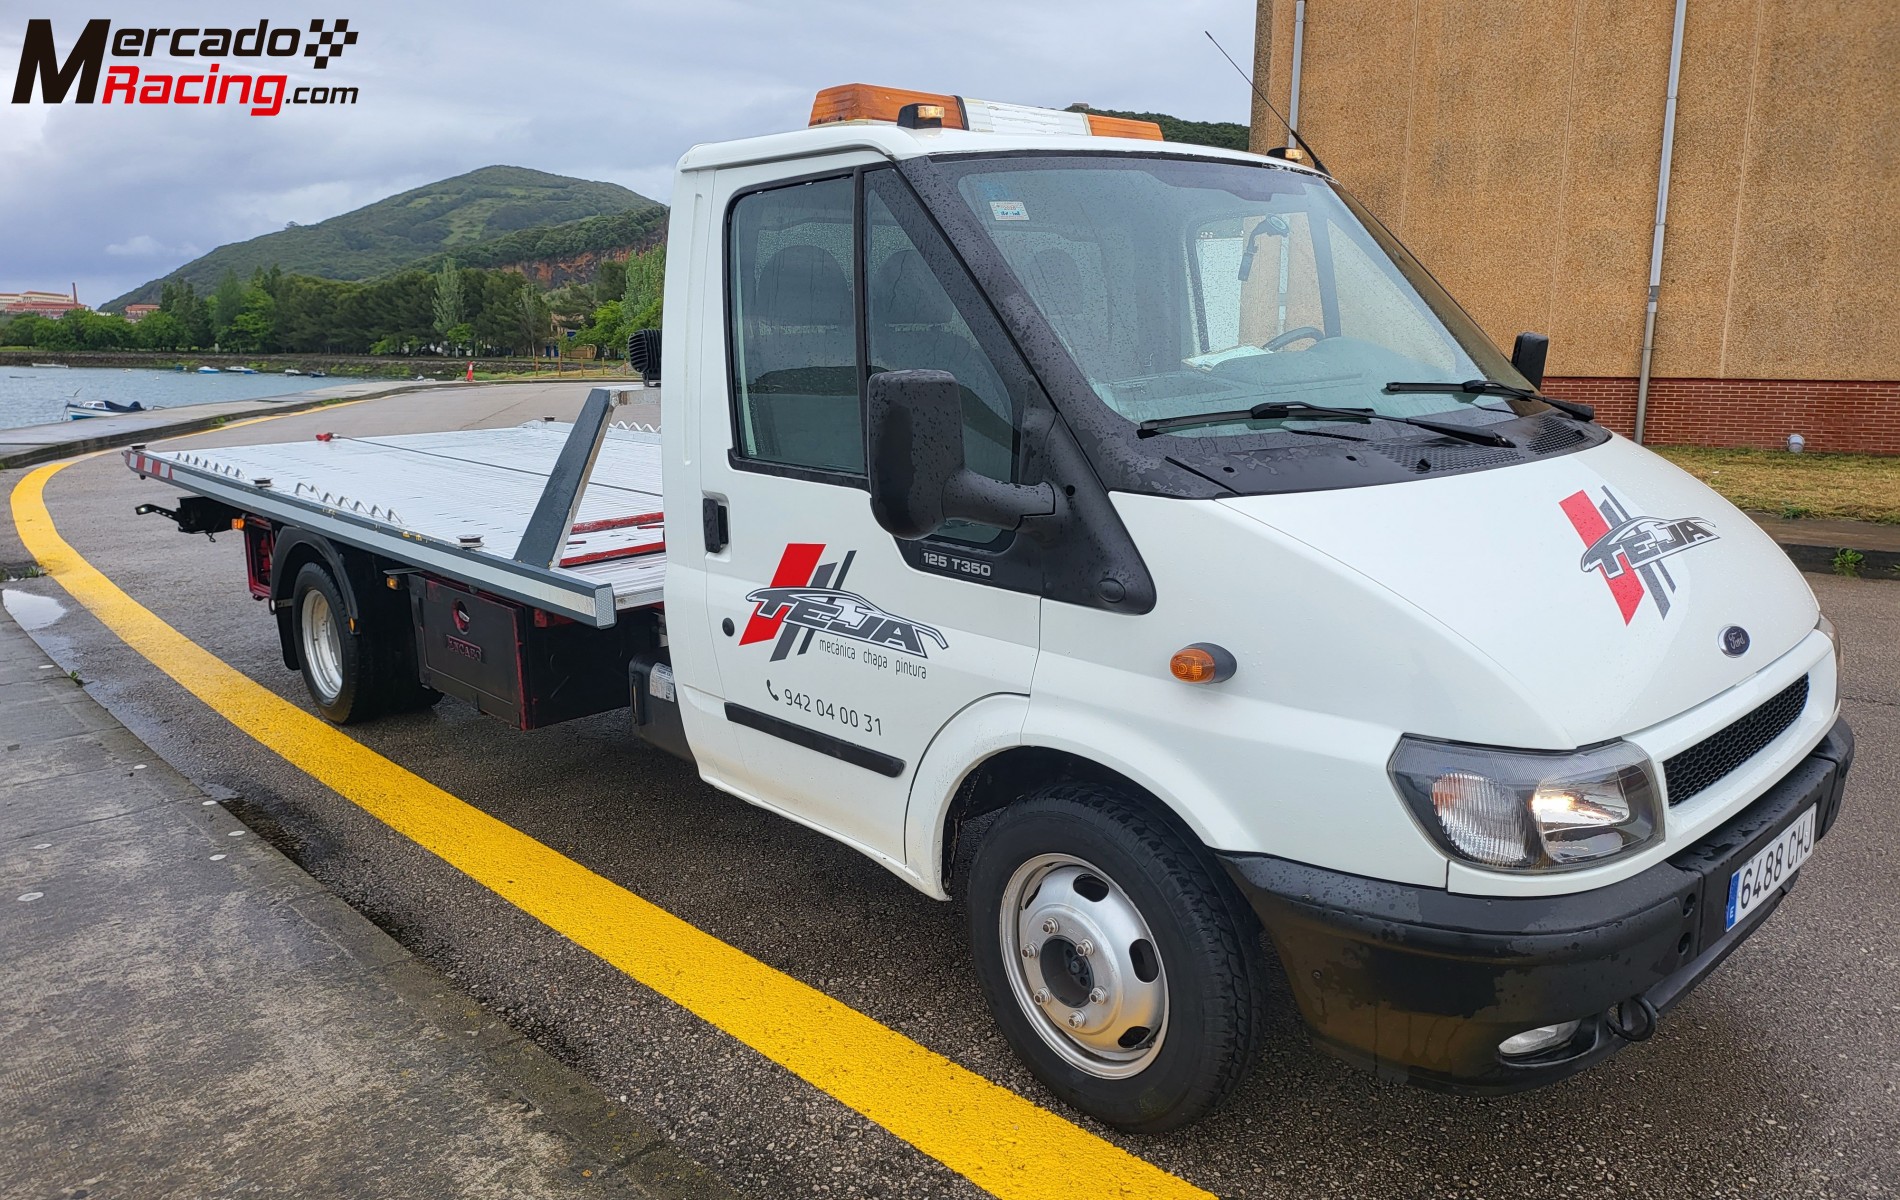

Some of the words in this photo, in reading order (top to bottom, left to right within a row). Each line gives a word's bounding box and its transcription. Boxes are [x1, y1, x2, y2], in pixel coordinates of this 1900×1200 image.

[923, 552, 948, 568] 125
[951, 558, 992, 577] T350
[1581, 516, 1720, 580] TEJA
[746, 587, 929, 660] TEJA
[819, 638, 857, 660] mecánica
[862, 649, 889, 671] chapa
[895, 656, 928, 680] pintura
[784, 688, 812, 713] 942
[816, 698, 836, 721] 04
[839, 706, 859, 729] 00
[863, 713, 883, 737] 31
[1740, 842, 1785, 910] 6488
[1786, 813, 1815, 871] CHJ
